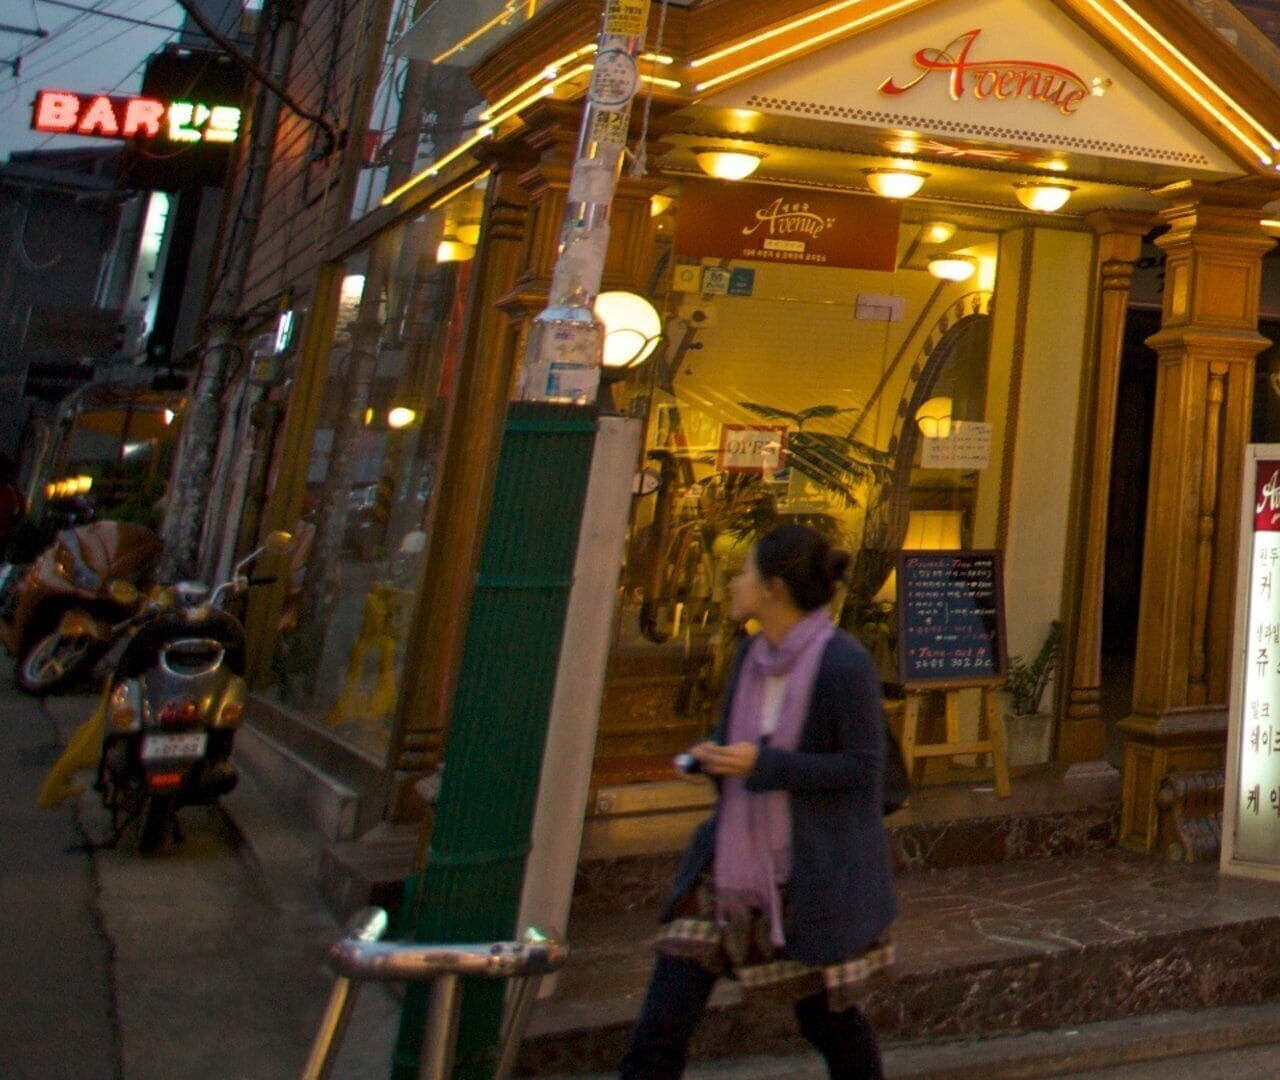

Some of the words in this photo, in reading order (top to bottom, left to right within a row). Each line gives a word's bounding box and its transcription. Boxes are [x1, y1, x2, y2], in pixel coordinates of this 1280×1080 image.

[878, 29, 1089, 114] Avenue
[35, 90, 165, 137] BAR
[742, 197, 825, 238] Avenue
